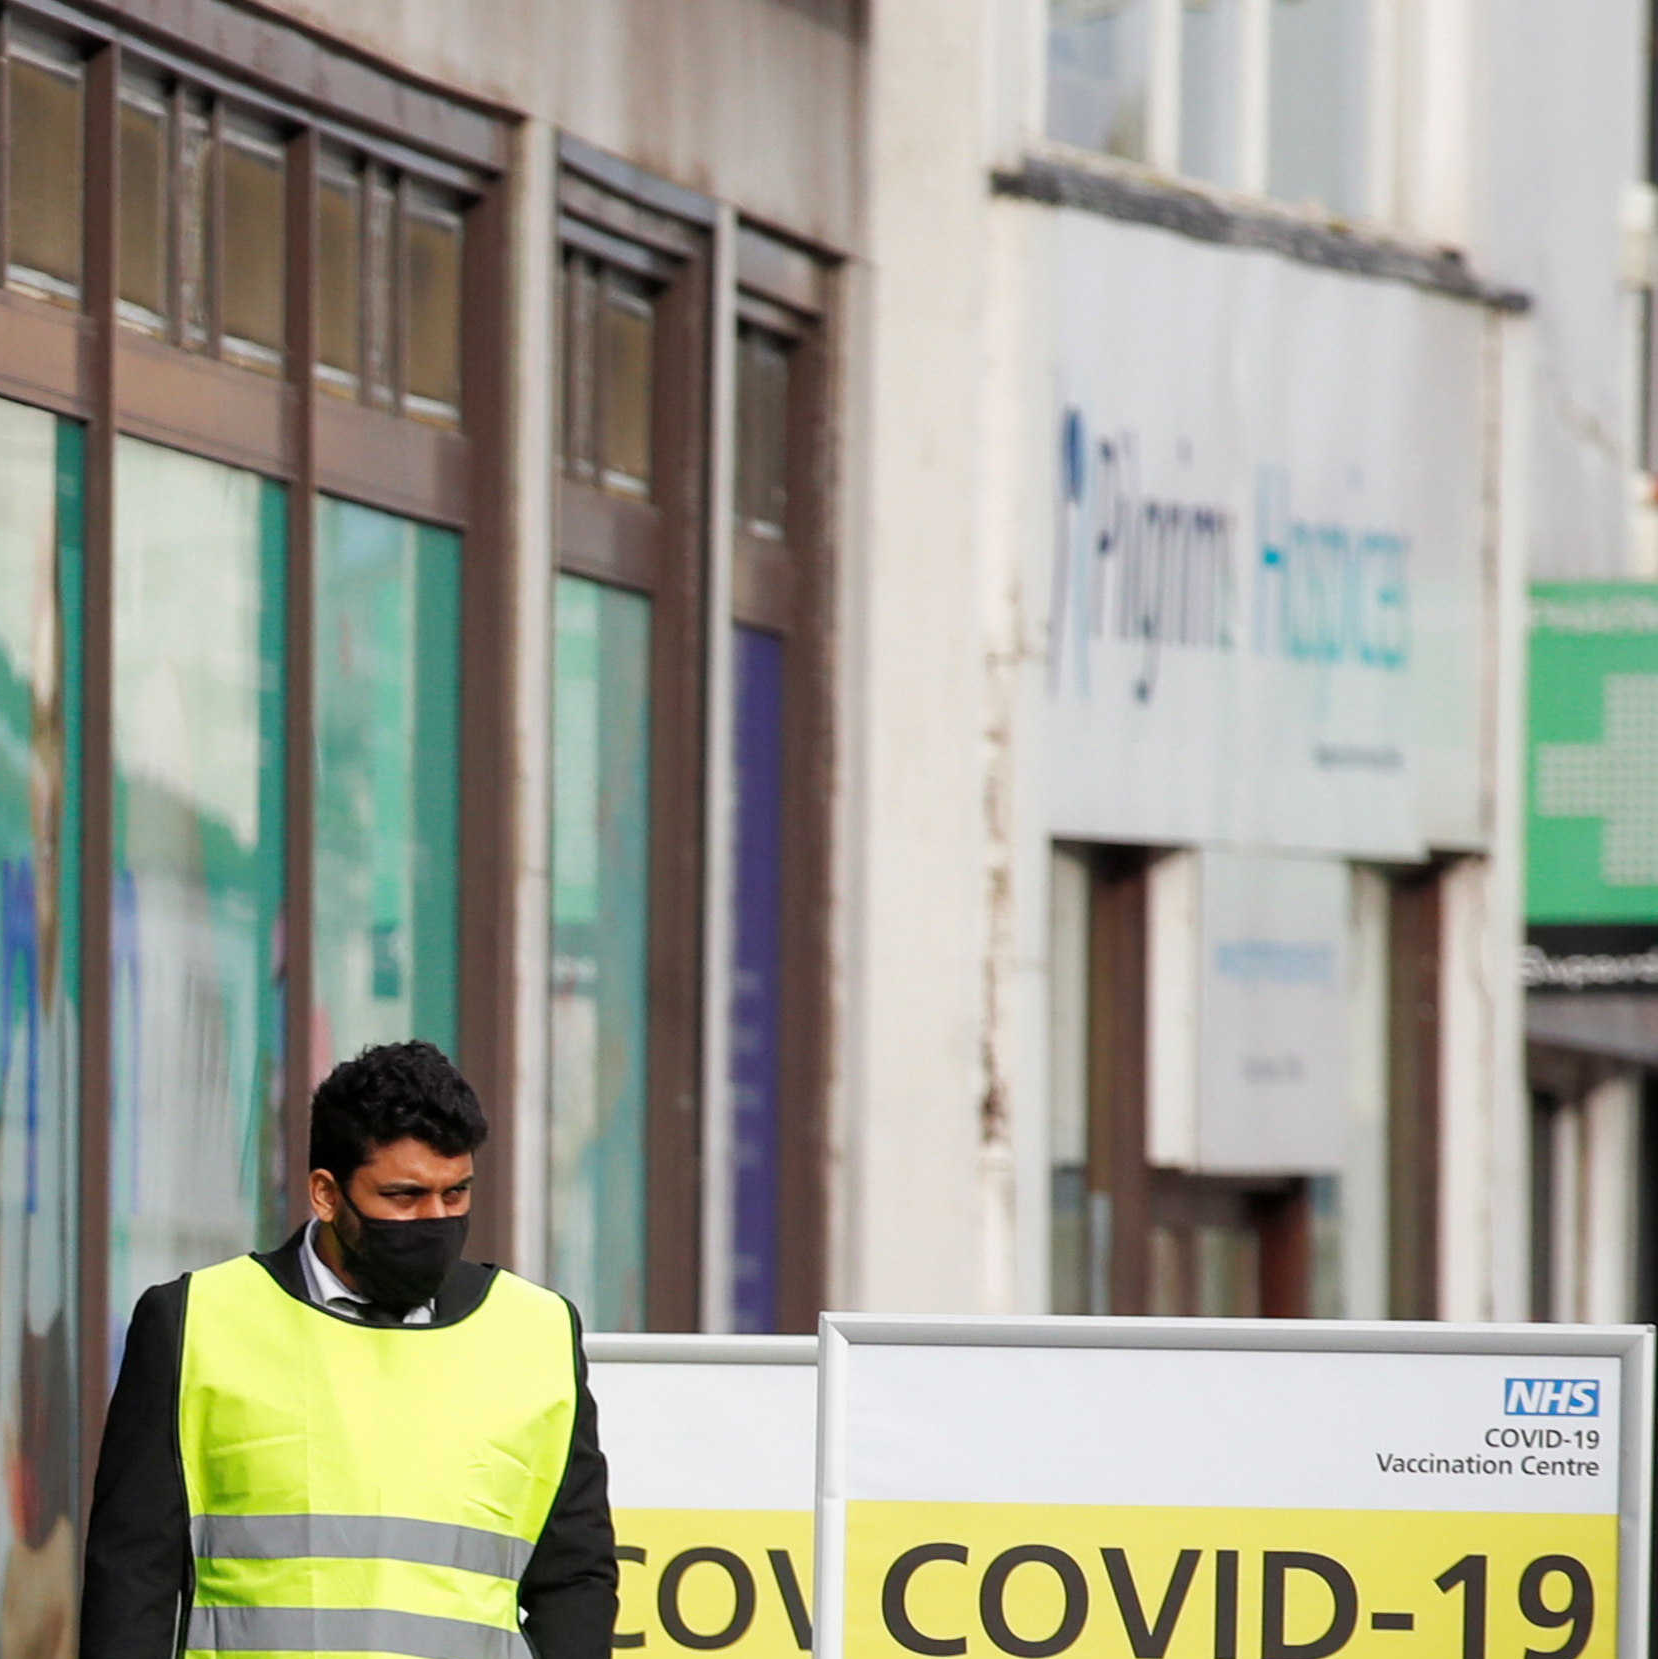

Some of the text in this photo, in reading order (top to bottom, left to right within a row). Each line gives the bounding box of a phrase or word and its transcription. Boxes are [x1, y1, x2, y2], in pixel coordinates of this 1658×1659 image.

[1505, 1380, 1598, 1415] NHS
[1484, 1427, 1600, 1450] COVID-19
[1375, 1452, 1600, 1477] Vaccination Centre
